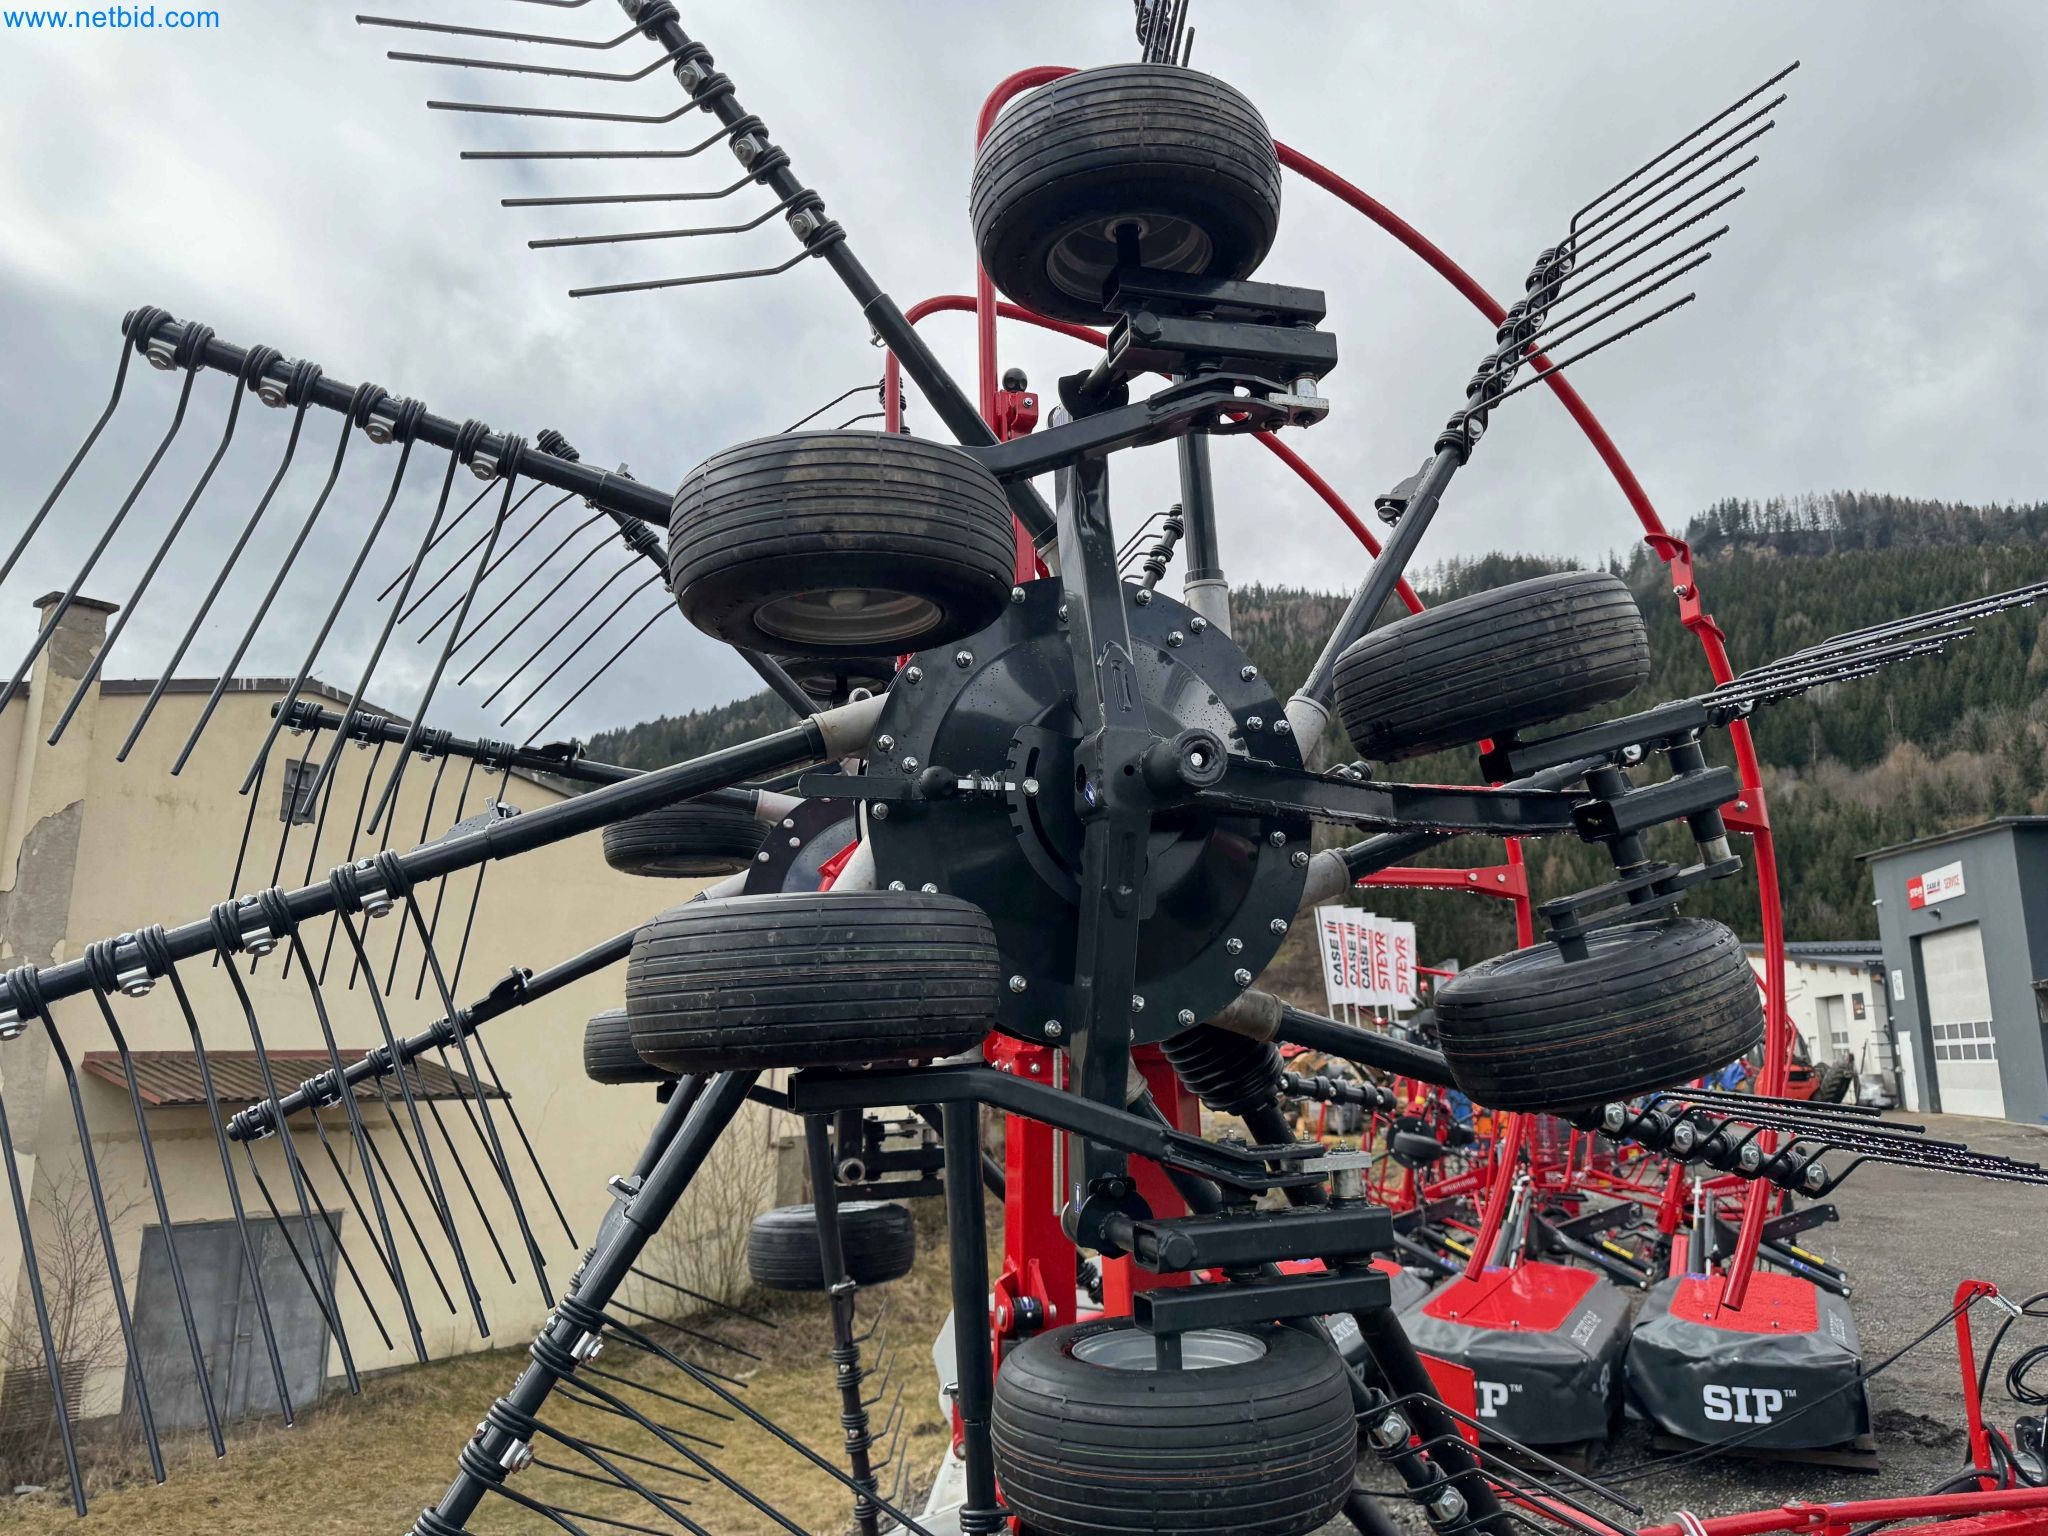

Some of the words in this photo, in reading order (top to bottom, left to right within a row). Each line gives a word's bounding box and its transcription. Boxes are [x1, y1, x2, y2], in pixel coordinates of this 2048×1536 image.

[1329, 938, 1344, 986] CASE
[1347, 940, 1358, 986] CASE
[1360, 945, 1371, 989] CASE
[1374, 931, 1391, 991] STEYR
[1395, 936, 1409, 995] STEYR
[1703, 1384, 1783, 1424] SIP
